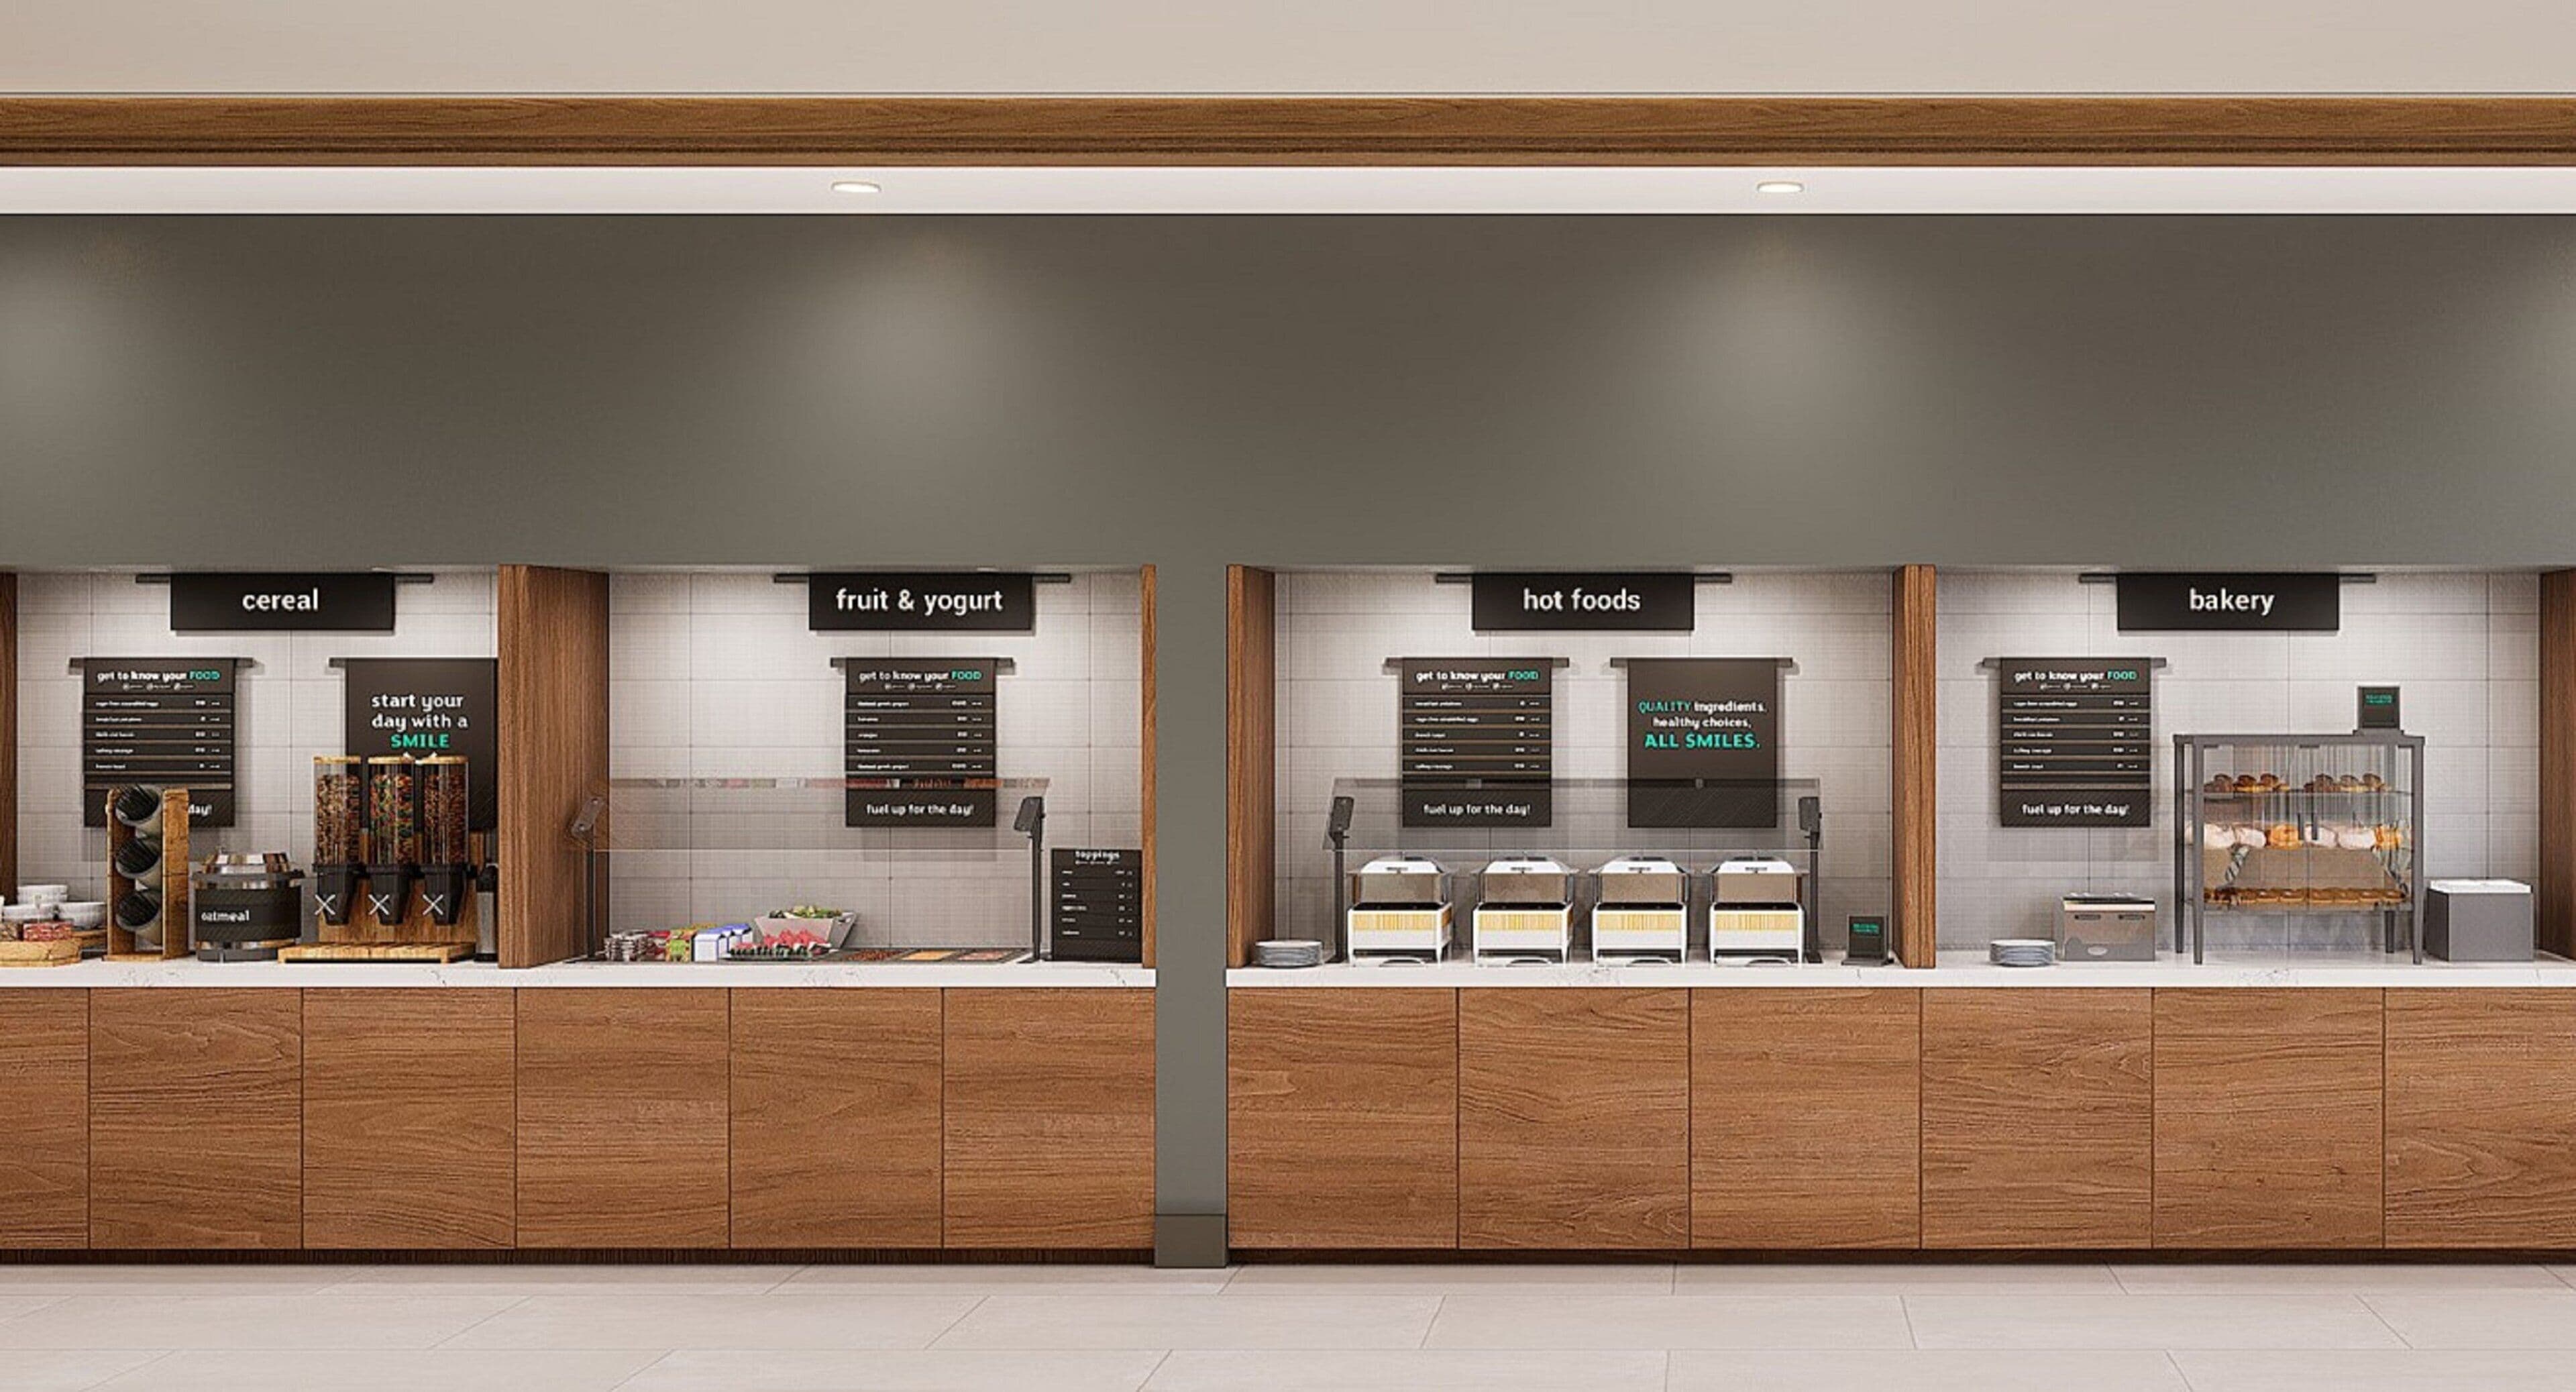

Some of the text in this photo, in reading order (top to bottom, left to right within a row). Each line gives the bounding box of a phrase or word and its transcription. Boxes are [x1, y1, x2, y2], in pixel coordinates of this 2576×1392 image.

[242, 588, 318, 610] cereal
[836, 588, 1003, 616] fruit & yogurt
[1523, 588, 1640, 610] hot foods
[2190, 588, 2275, 616] bakery
[117, 671, 129, 680] to
[131, 670, 160, 680] know
[162, 672, 187, 684] your
[189, 671, 221, 680] FOOD
[859, 670, 982, 684] get to know your FOOD
[1415, 670, 1539, 684] get to know your FOOD
[2015, 670, 2137, 684] get to know your FOOD
[372, 694, 464, 712] start your
[1638, 702, 1691, 714] QUALITY
[372, 712, 468, 733] day with a
[1652, 716, 1700, 731] healthy
[390, 733, 449, 748] SMILE
[1644, 733, 1760, 749] ALL SMILES.
[866, 804, 889, 814] fuel
[890, 806, 906, 816] up
[908, 804, 926, 814] for
[927, 804, 947, 814] the
[1423, 804, 1531, 817] fuel up for the day!
[2021, 804, 2044, 814] fuel
[2047, 806, 2062, 816] up
[2063, 804, 2081, 814] for
[2083, 804, 2103, 814] the
[1075, 850, 1120, 862] toppings
[201, 909, 250, 923] oatmeal
